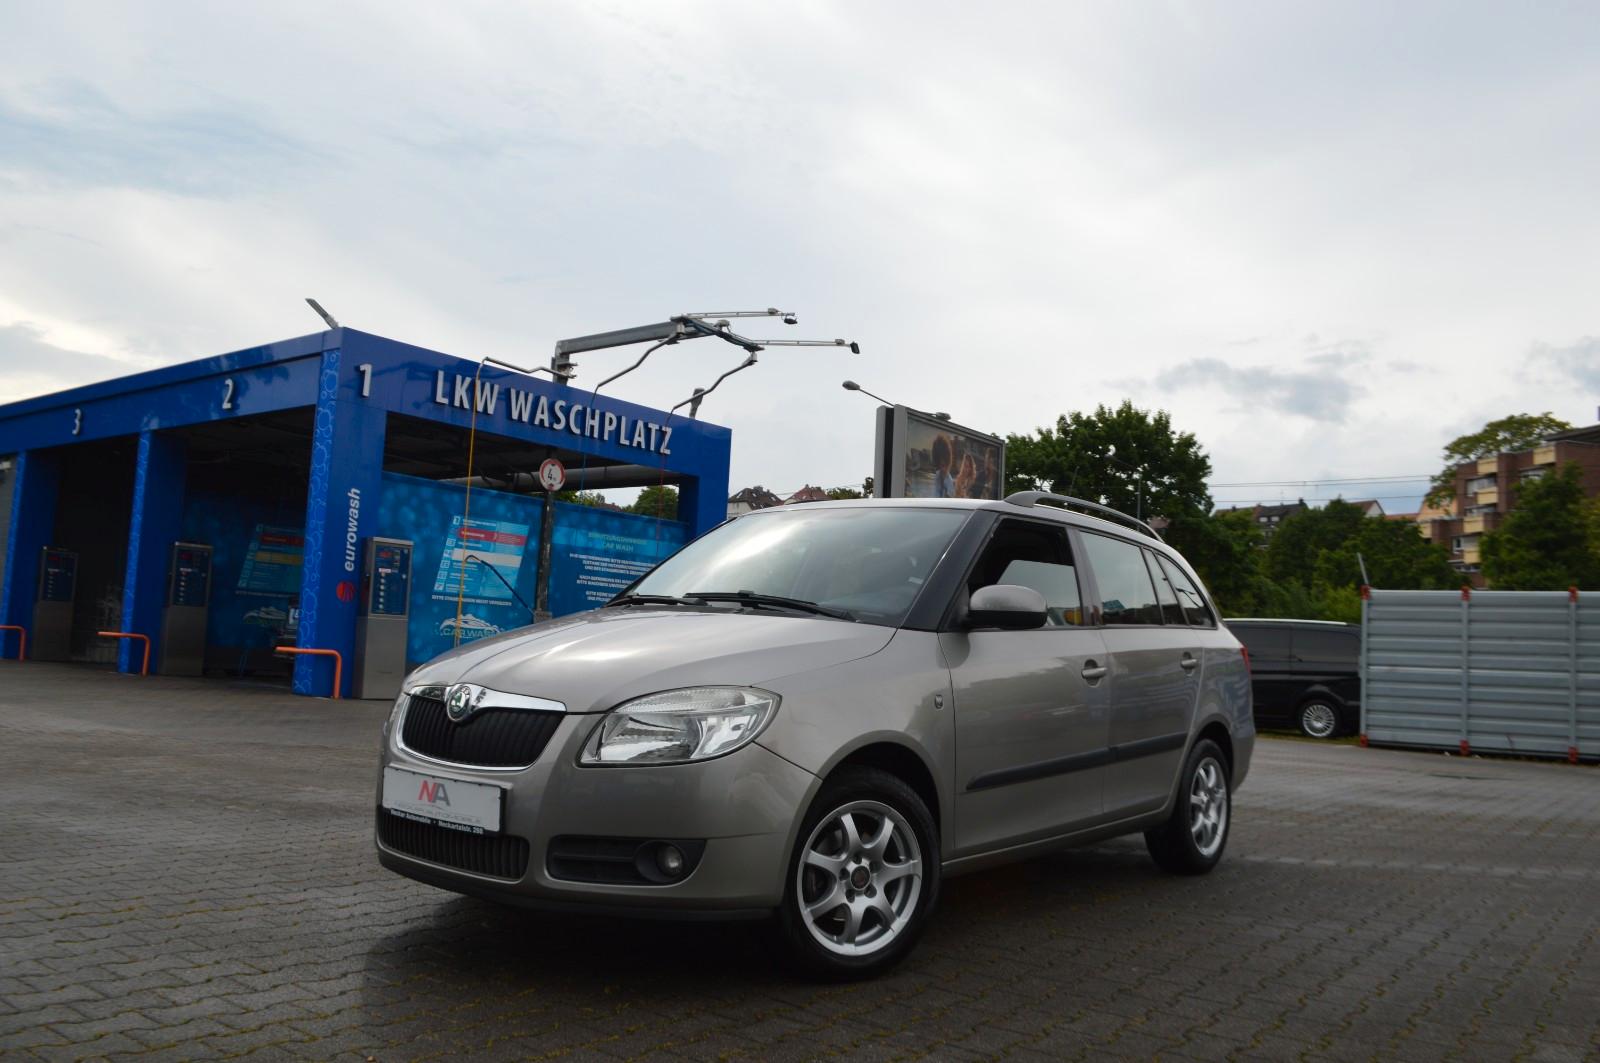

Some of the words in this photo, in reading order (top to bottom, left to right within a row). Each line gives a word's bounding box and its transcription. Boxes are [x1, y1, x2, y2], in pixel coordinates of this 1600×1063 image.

[222, 378, 235, 410] 2
[360, 363, 373, 398] 1
[72, 408, 82, 436] 3
[435, 370, 500, 416] LKW
[510, 387, 672, 456] WASCHPLATZ
[344, 487, 361, 572] eurowash
